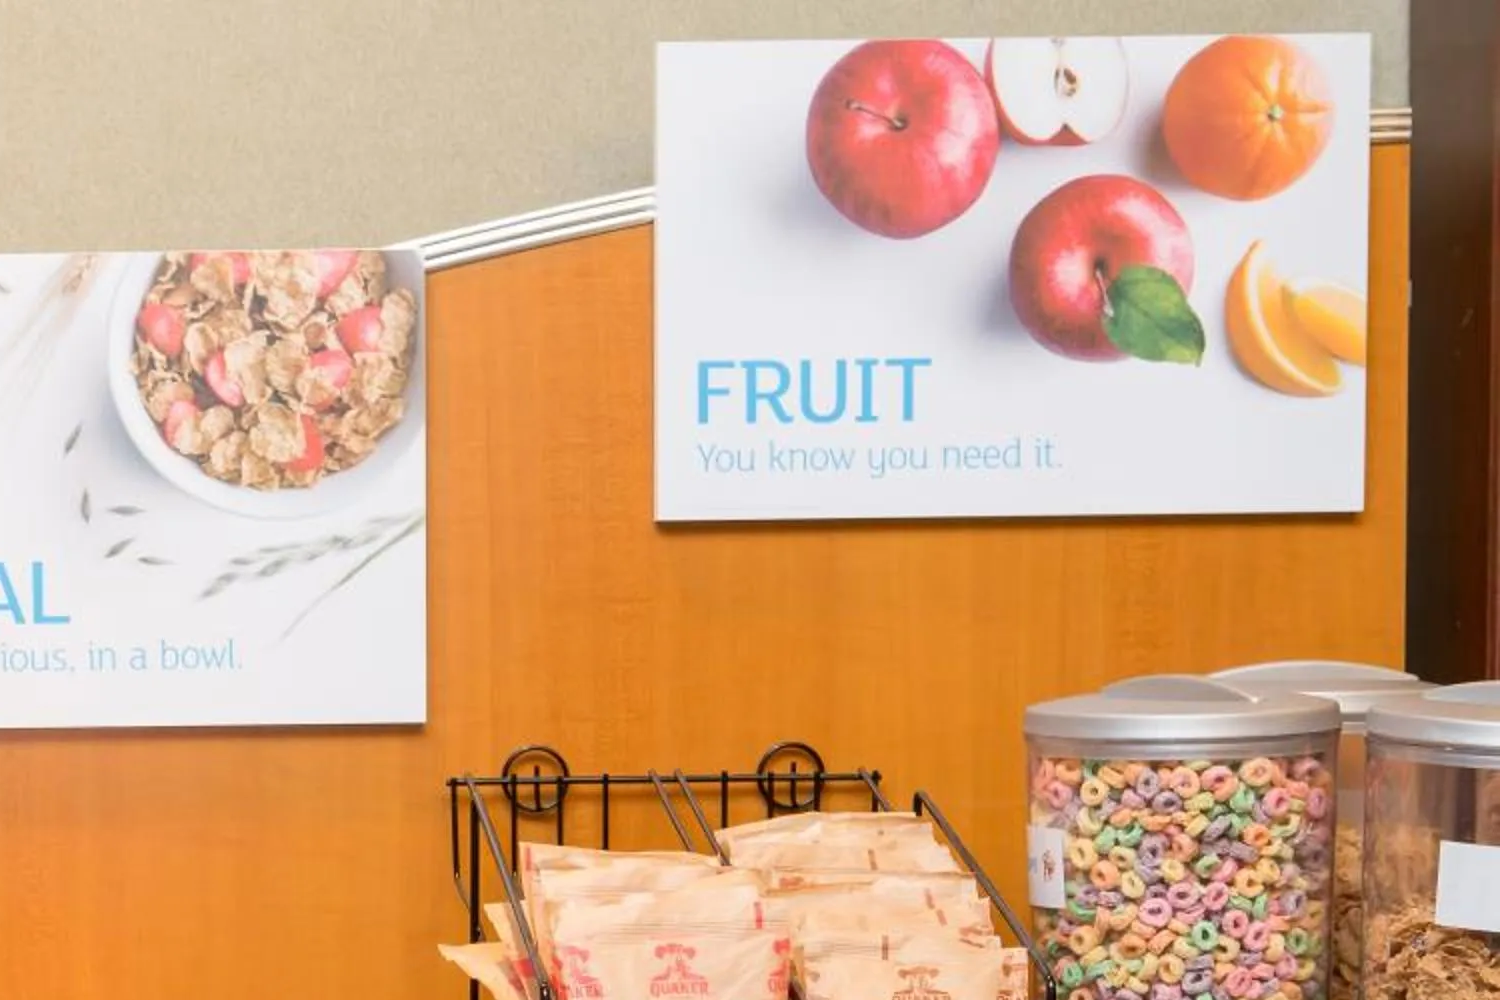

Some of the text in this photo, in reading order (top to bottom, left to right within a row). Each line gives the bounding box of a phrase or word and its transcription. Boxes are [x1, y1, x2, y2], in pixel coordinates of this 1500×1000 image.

[697, 356, 932, 425] FRUIT
[697, 436, 1063, 478] You know you need it.
[88, 642, 117, 672] in
[128, 650, 148, 671] a
[160, 638, 243, 672] bowl.
[649, 981, 709, 996] QUAKER
